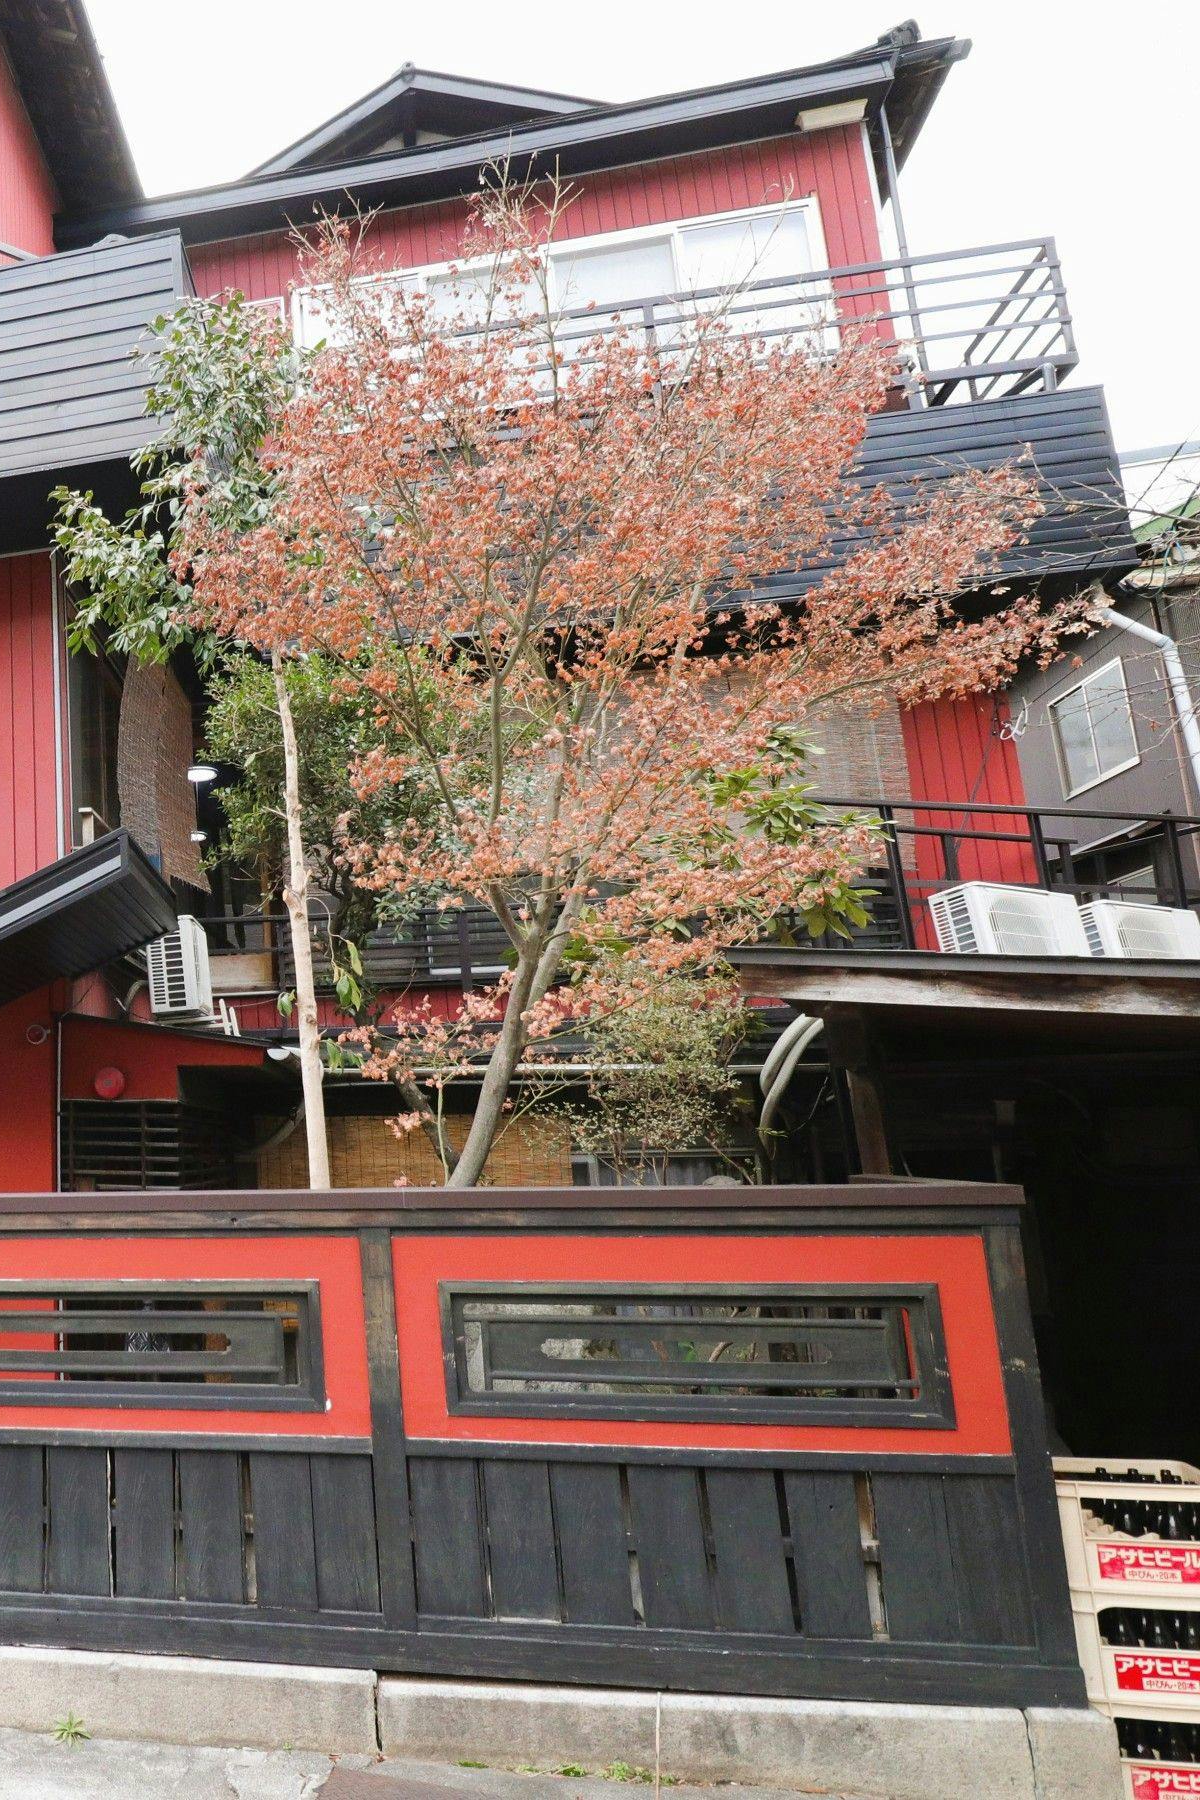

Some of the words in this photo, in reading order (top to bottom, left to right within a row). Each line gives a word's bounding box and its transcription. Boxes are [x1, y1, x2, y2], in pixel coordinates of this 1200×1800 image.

[1098, 1547, 1200, 1569] アサヒビール
